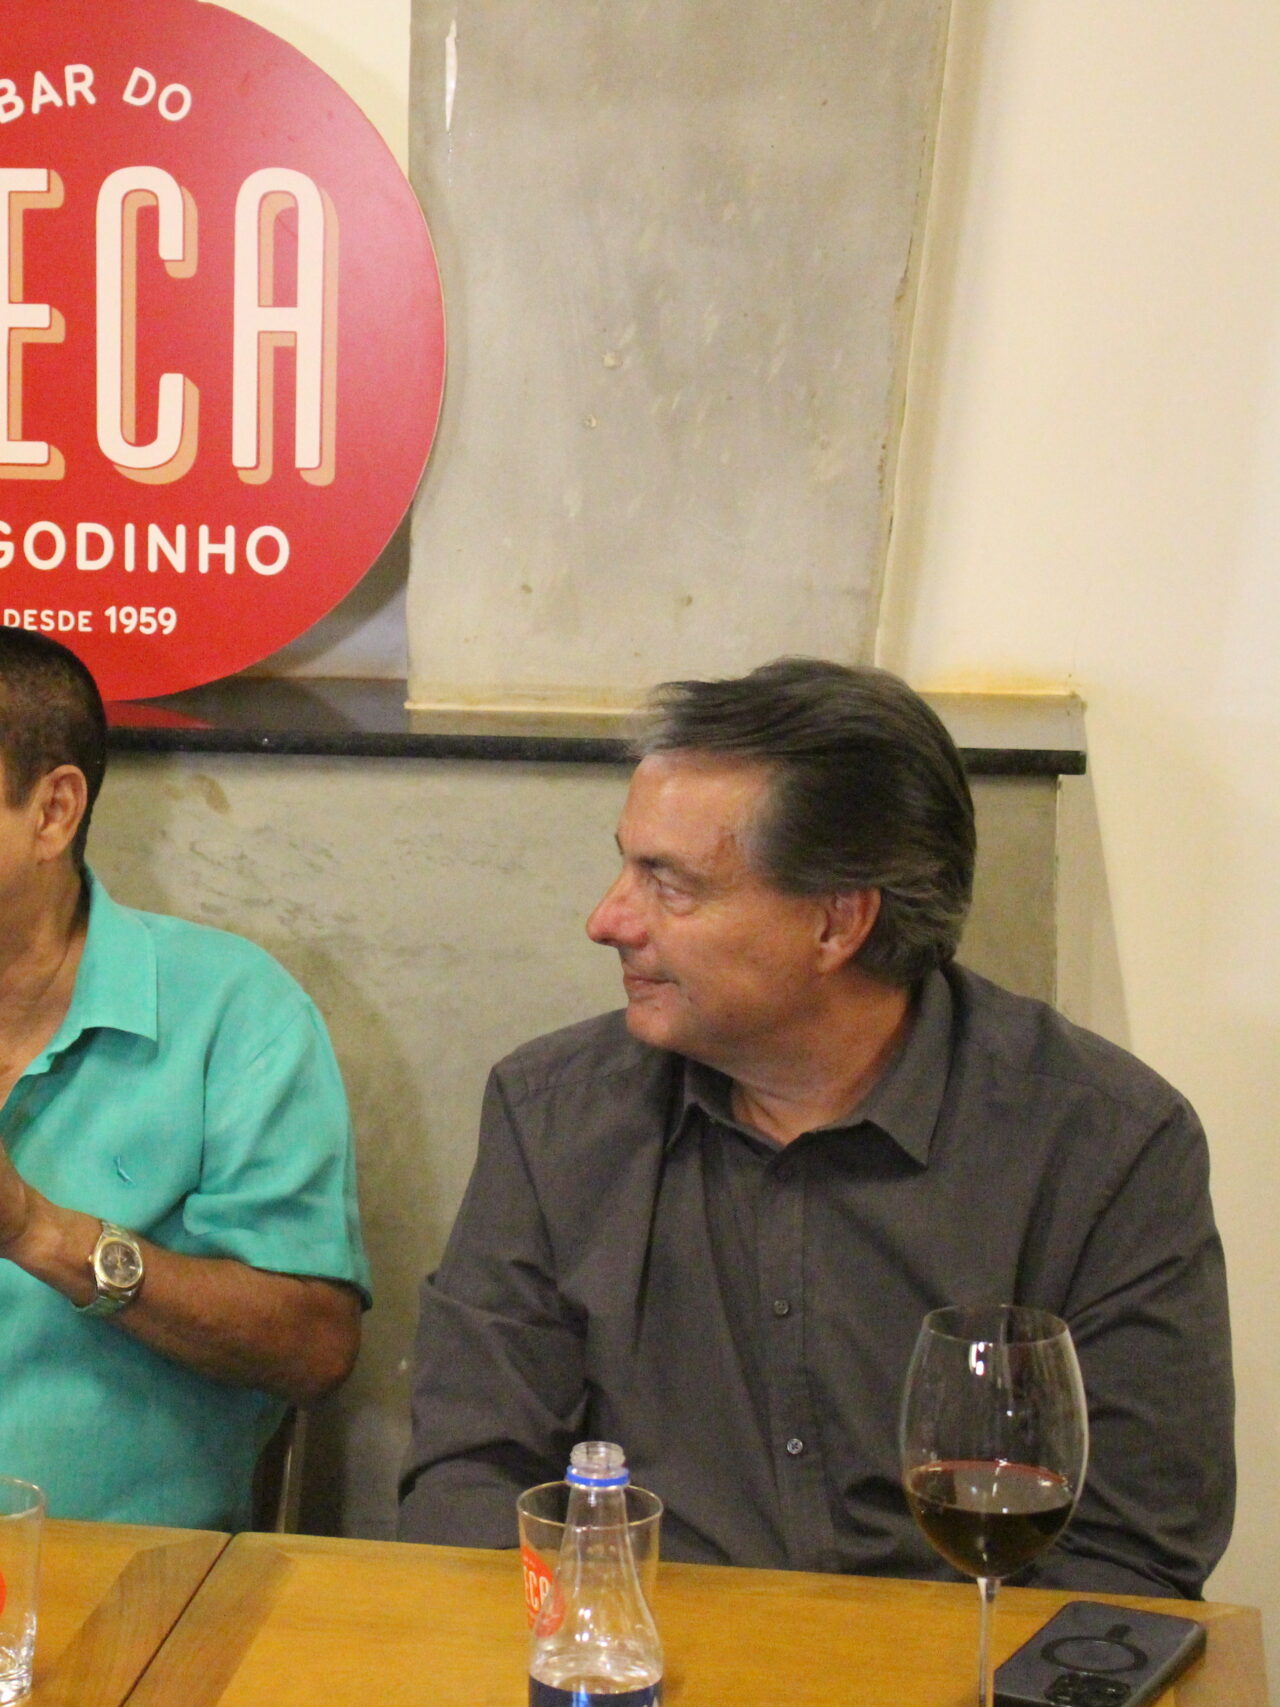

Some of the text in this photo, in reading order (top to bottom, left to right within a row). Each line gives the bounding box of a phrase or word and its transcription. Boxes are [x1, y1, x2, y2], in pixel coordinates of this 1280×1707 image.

[123, 66, 192, 122] DO
[3, 605, 177, 635] DESDE 1959
